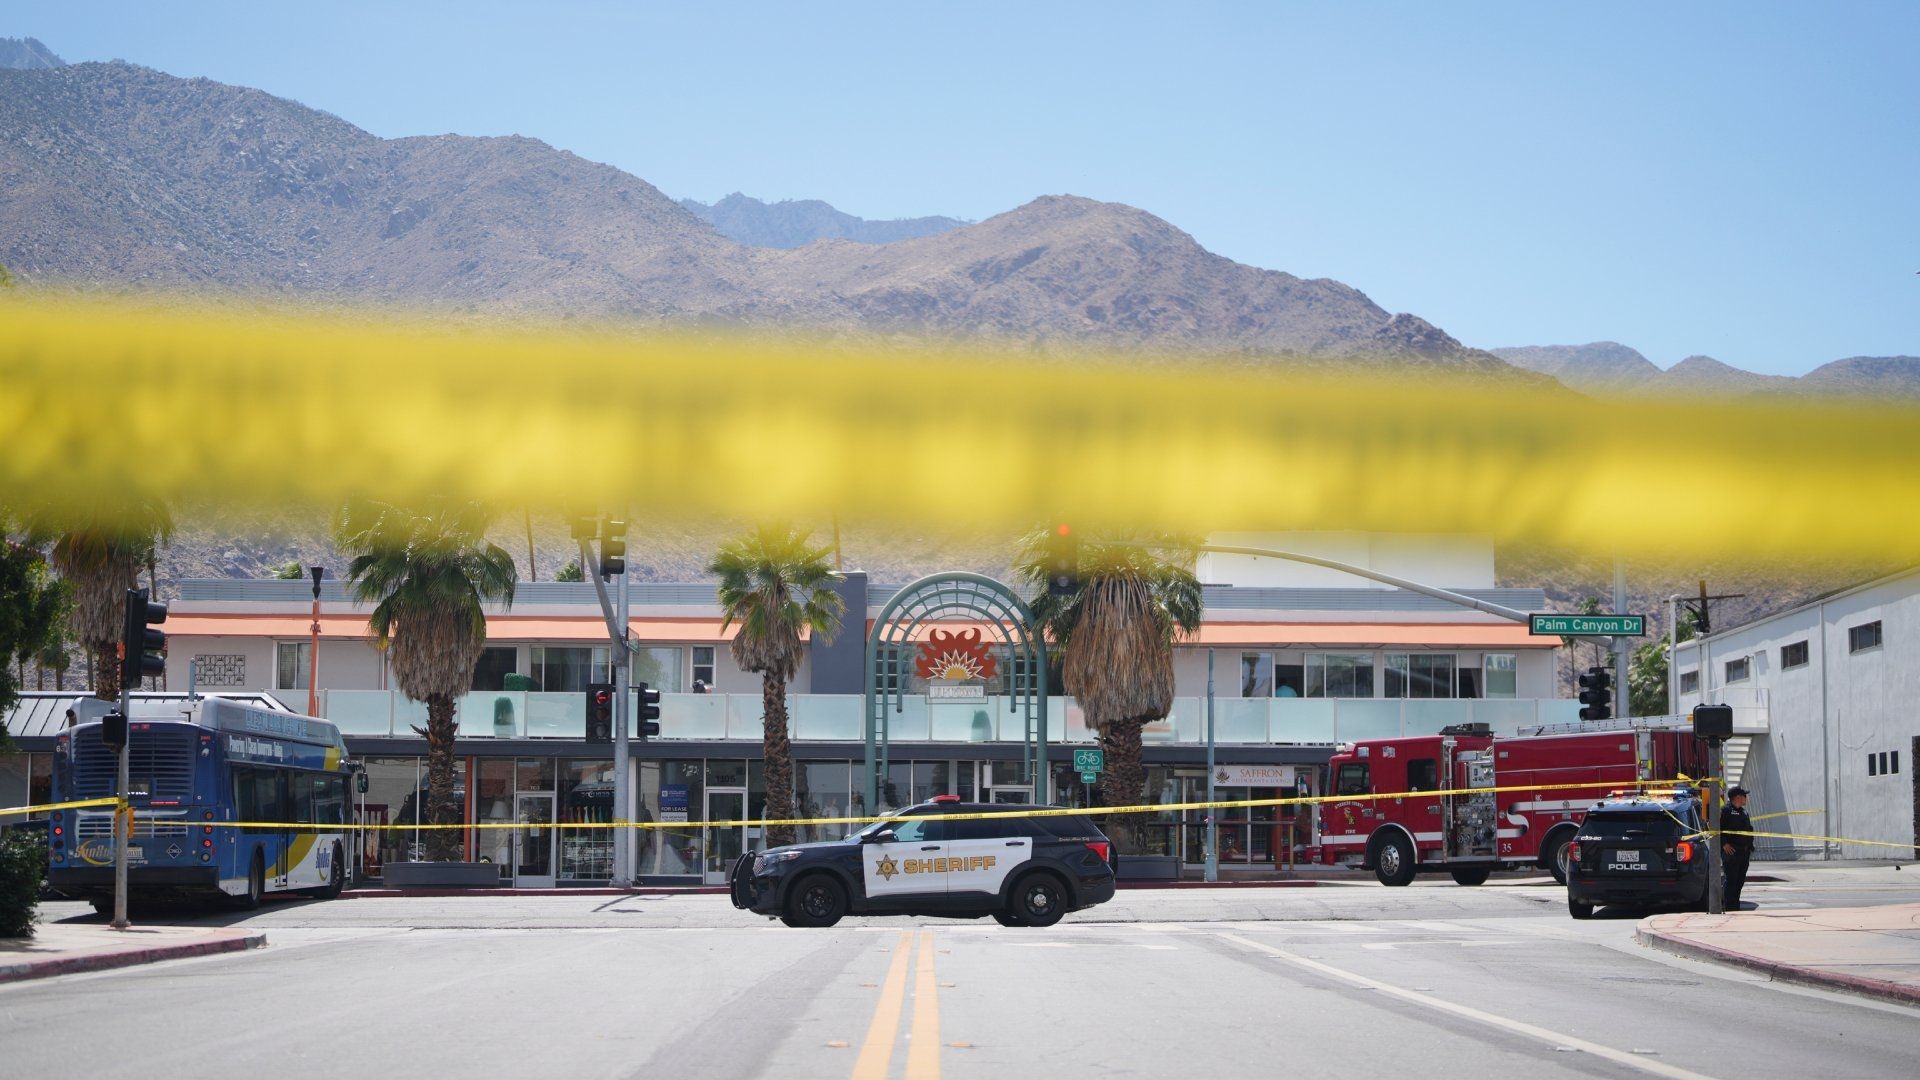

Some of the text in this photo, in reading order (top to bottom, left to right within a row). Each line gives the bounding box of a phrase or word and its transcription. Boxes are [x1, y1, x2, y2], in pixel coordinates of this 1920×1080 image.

[1536, 619, 1639, 633] Palm Canyon Dr
[1240, 768, 1283, 778] SAFFRON
[1502, 843, 1512, 853] 35
[903, 855, 996, 874] SHERIFF
[1608, 863, 1648, 871] POLICE
